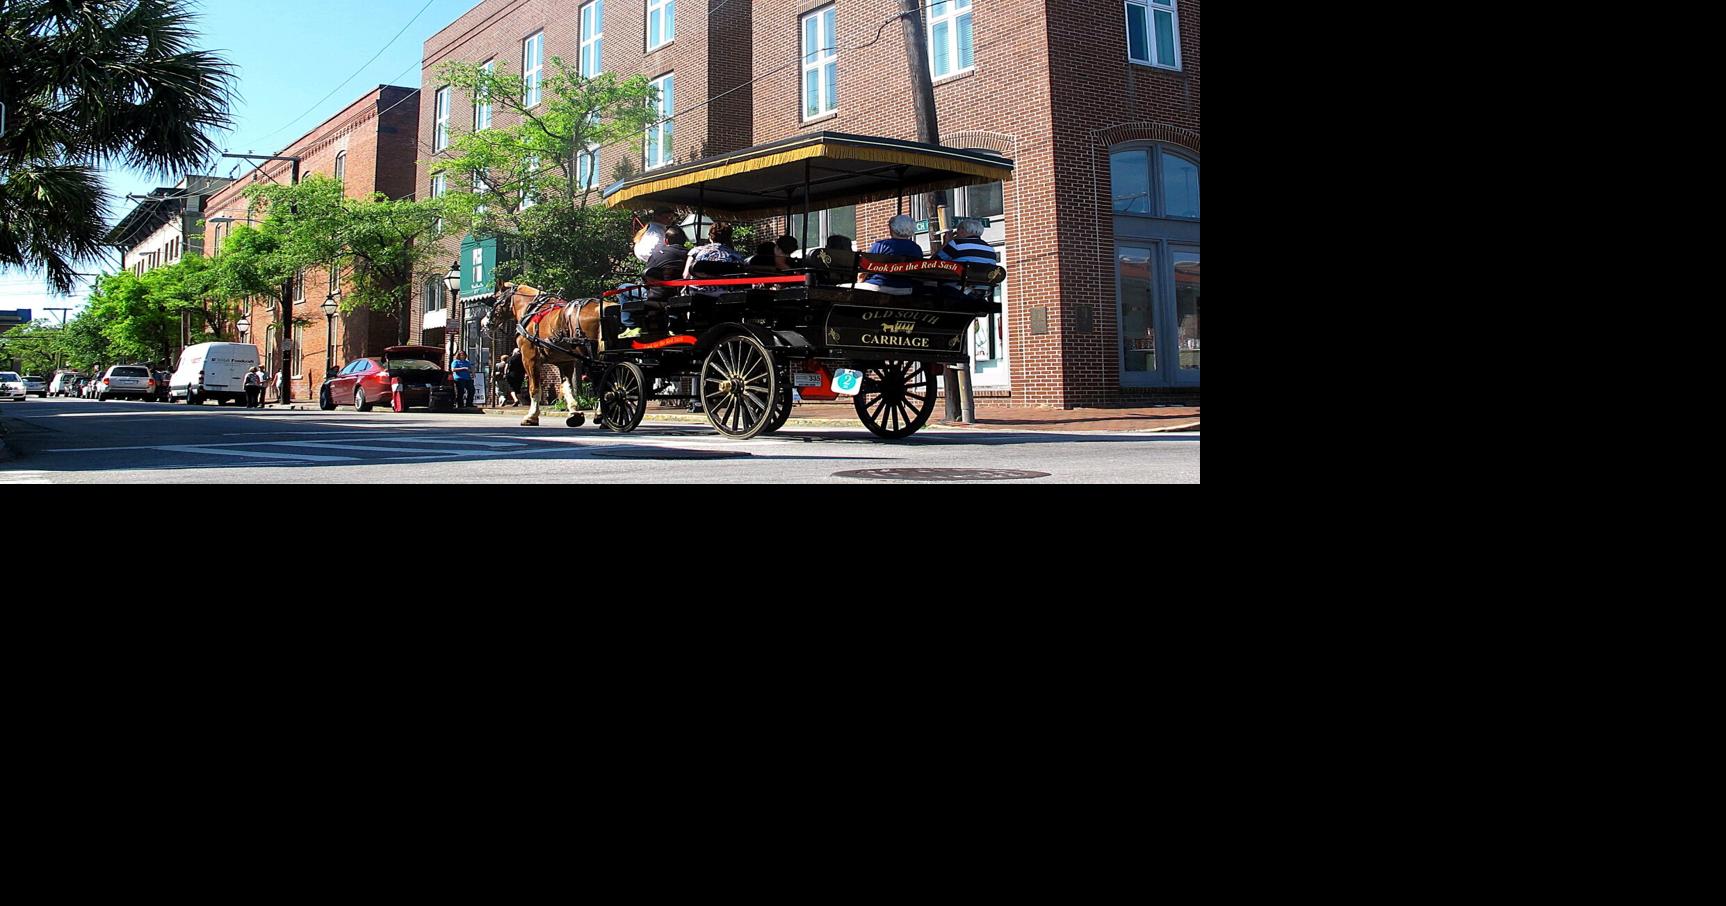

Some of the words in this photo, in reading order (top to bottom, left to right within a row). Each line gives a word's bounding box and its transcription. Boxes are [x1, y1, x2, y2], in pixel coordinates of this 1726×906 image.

[867, 262, 888, 272] Look
[889, 263, 904, 273] for
[905, 263, 919, 271] the
[921, 260, 937, 269] Red
[938, 261, 958, 271] Sash
[862, 310, 893, 321] OLD
[895, 310, 940, 325] SOUTH
[861, 334, 930, 348] CARRIAGE
[843, 374, 853, 385] 2
